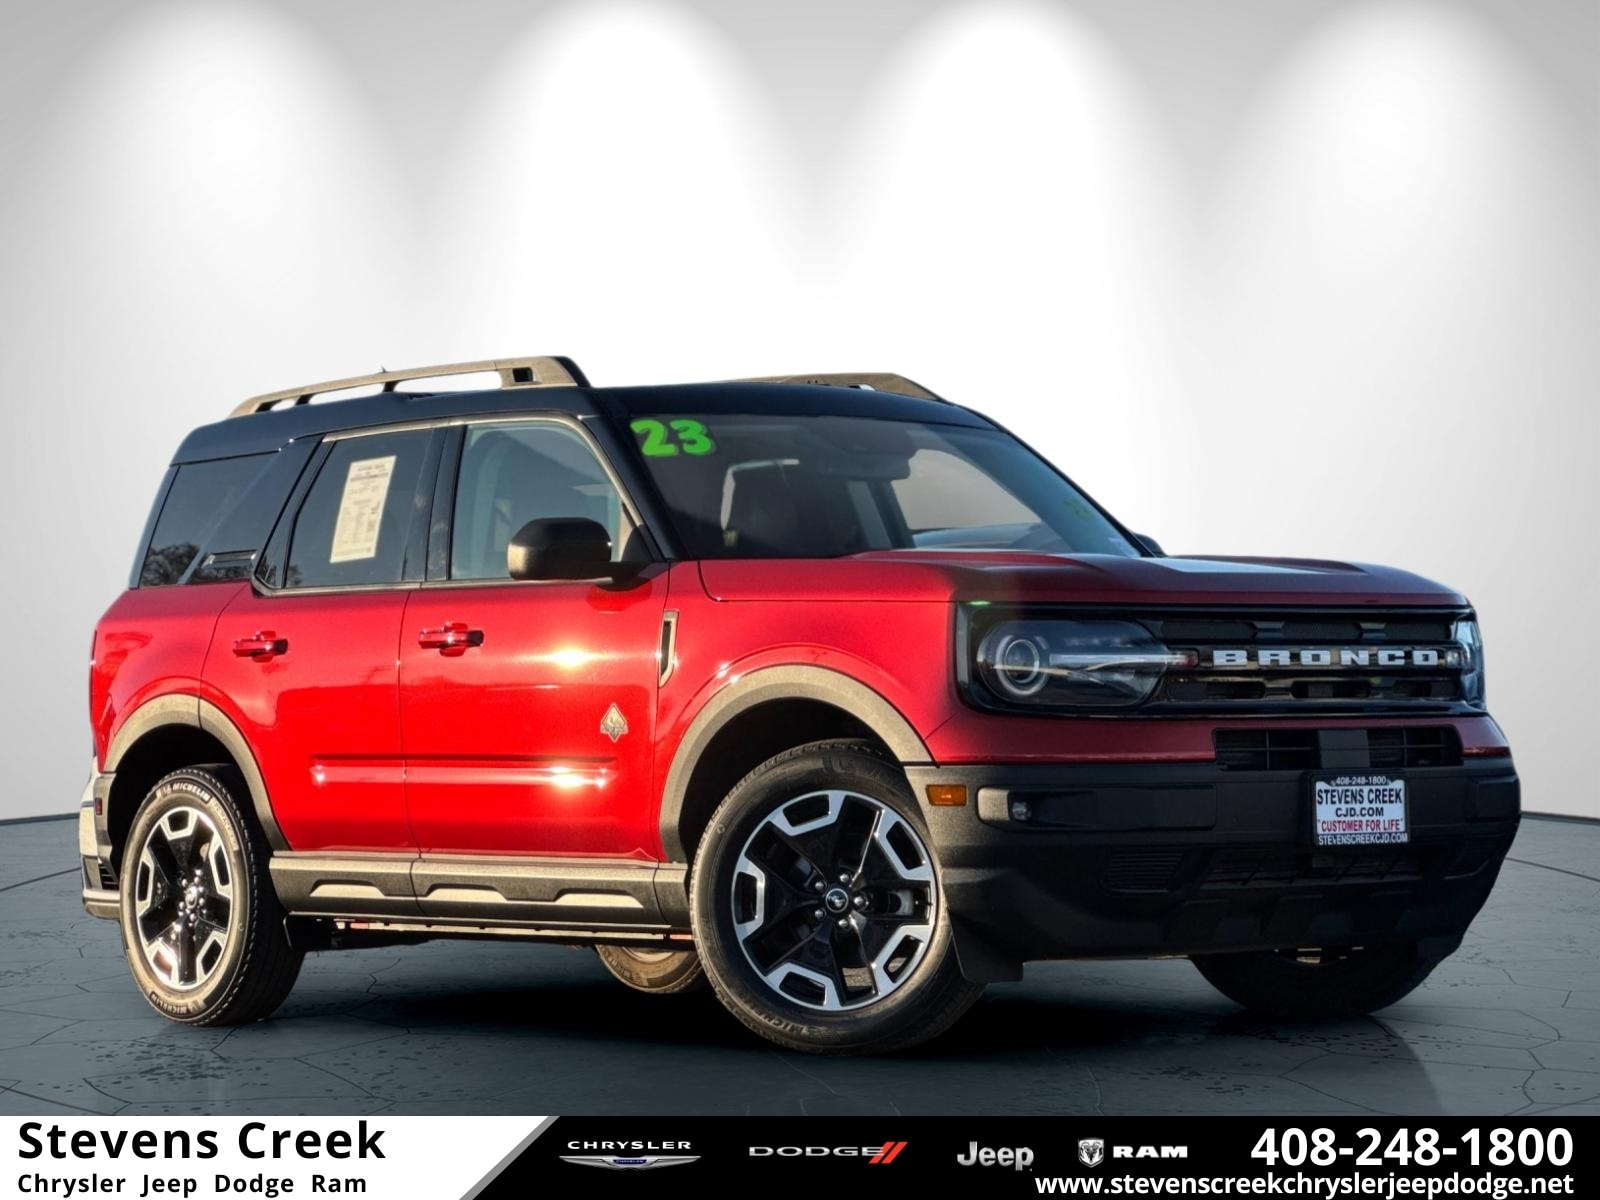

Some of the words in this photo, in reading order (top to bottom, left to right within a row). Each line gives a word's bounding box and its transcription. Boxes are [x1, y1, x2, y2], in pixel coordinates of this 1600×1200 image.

[629, 418, 716, 457] 23
[1212, 649, 1438, 666] BRONCO
[1336, 776, 1387, 786] 408-248-1800
[172, 782, 212, 803] MICHELIN
[1317, 788, 1365, 806] STEVENS
[1367, 788, 1402, 804] CREEK
[1335, 807, 1384, 818] CJD.COM
[1365, 819, 1382, 832] FOR
[1318, 832, 1408, 845] STEVENSCREEKCJD.COM
